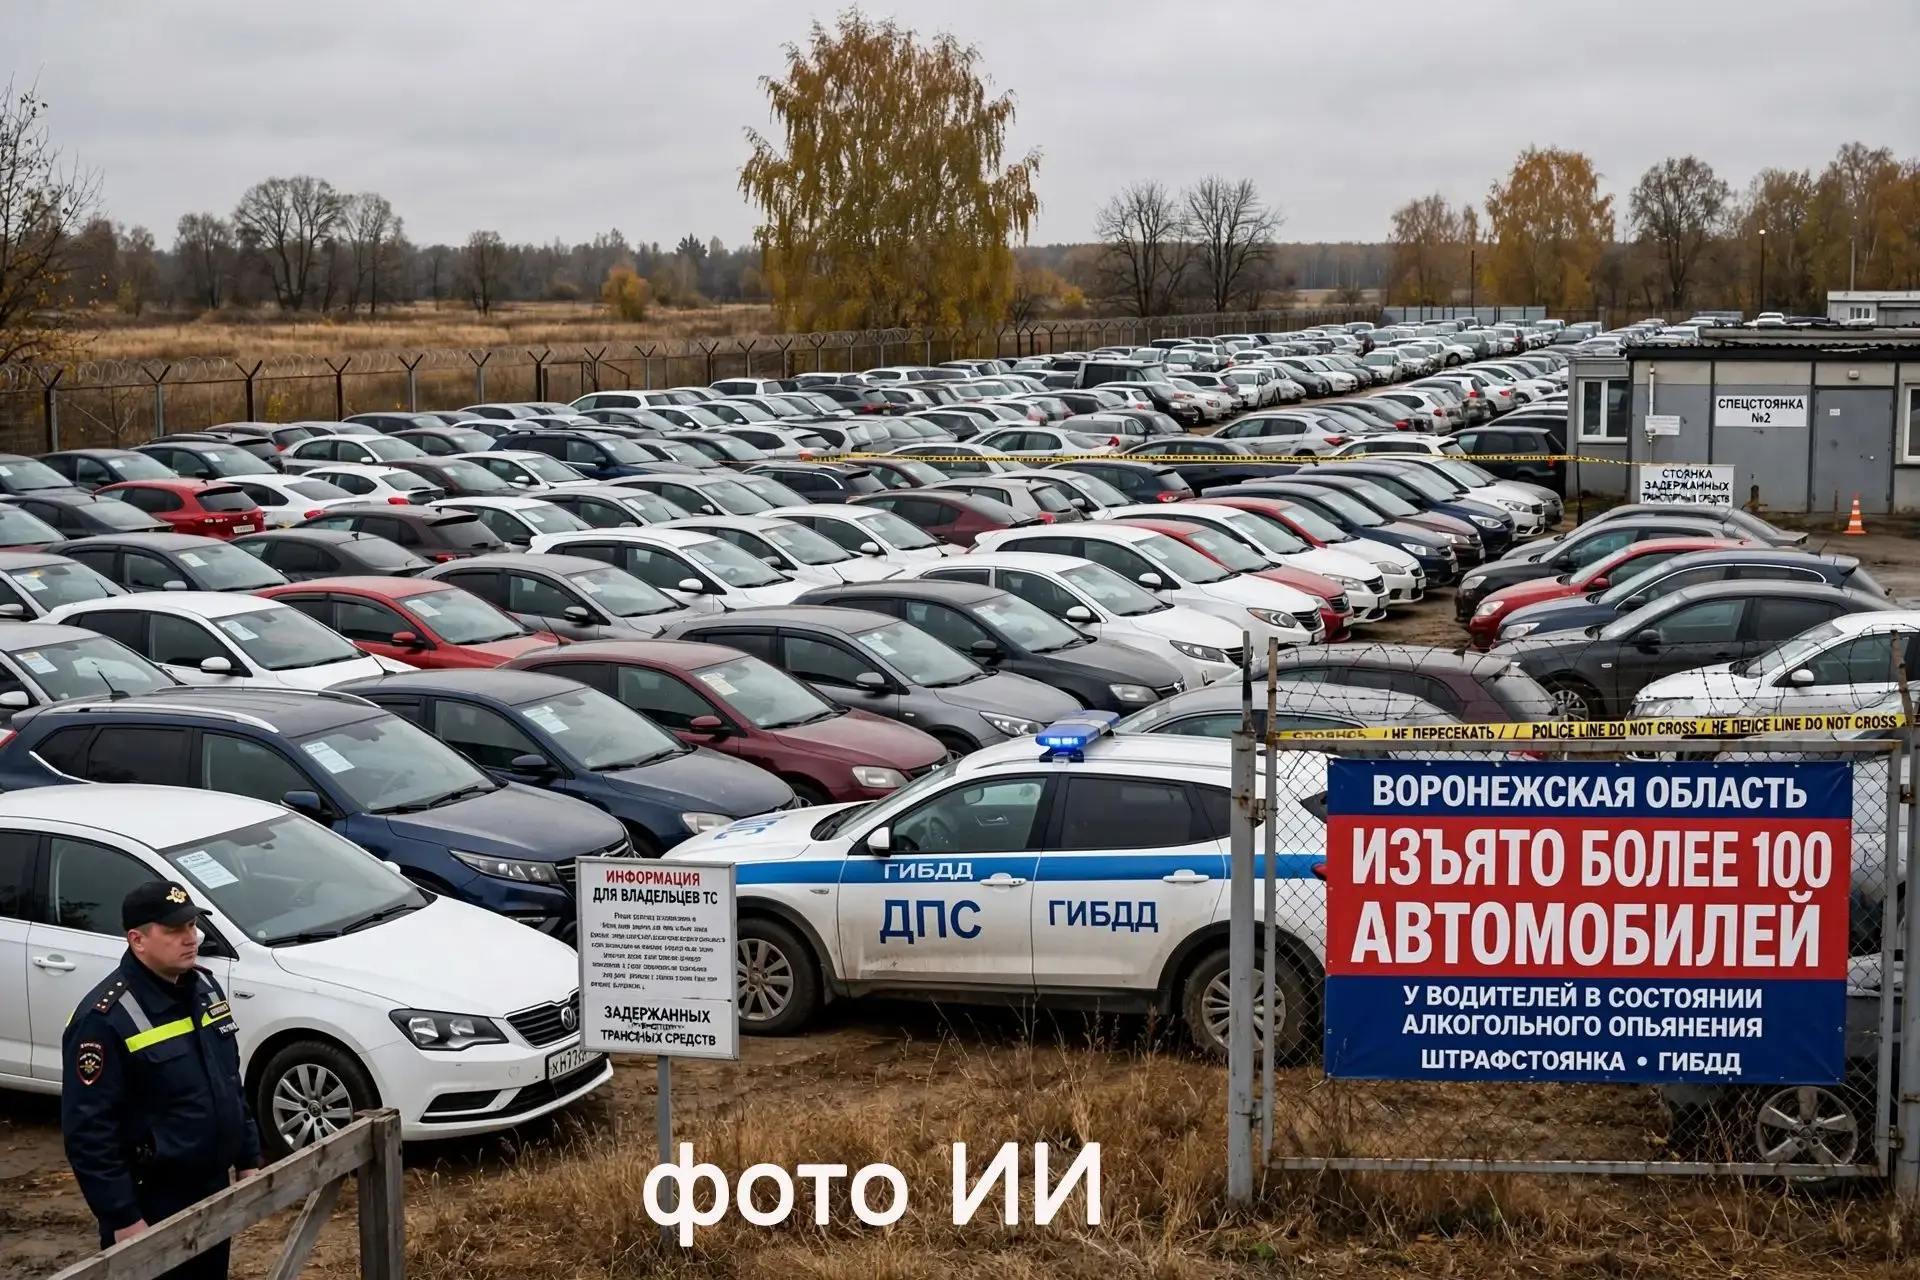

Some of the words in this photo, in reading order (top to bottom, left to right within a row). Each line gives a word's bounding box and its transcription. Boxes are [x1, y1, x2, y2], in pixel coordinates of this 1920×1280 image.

[1718, 398, 1804, 411] СПЕЦСТОЯНКА
[1751, 412, 1771, 424] №2
[1662, 468, 1713, 479] СТОЯНКА
[1644, 480, 1730, 491] ЗАДЕРЖАННЫХ
[1391, 728, 1408, 739] НЕ
[1412, 725, 1496, 740] ПЕРЕСЕКАТЬ
[1532, 722, 1575, 739] POLICE
[1579, 723, 1605, 738] LINE
[1609, 722, 1626, 736] DO
[1629, 722, 1654, 736] NOT
[1657, 721, 1698, 735] CROSS
[1774, 717, 1801, 731] LINE
[1805, 716, 1823, 730] DO
[1827, 716, 1852, 729] NOT
[1855, 715, 1898, 729] CROSS
[1372, 774, 1635, 808] ВОРОНЕЖСКАЯ
[1645, 776, 1808, 809] ОБЛАСТЬ
[1351, 827, 1566, 887] ИЗЪЯТО
[1581, 829, 1740, 888] БОЛЕЕ
[1752, 830, 1832, 889] 100
[606, 870, 700, 888] ИНФОРМАЦИЯ
[884, 862, 974, 881] ГИБДД
[593, 887, 617, 903] ДЛЯ
[621, 888, 700, 906] ВЛАДЕЛЬЦЕВ
[703, 891, 718, 905] ТС
[879, 899, 983, 945] ДПС
[1048, 900, 1159, 933] ГИБДД
[1350, 890, 1820, 968] АВТОМОБИЛЕЙ
[1403, 985, 1420, 1006] У
[1426, 982, 1577, 1010] ВОДИТЕЛЕЙ
[1585, 987, 1601, 1007] В
[1608, 987, 1763, 1009] СОСТОЯНИИ
[604, 1005, 711, 1023] ЗАДЕРЖАННЫХ
[1402, 1014, 1601, 1037] АЛКОГОЛЬНОГО
[1608, 1016, 1763, 1038] ОПЬЯНЕНИЯ
[664, 1032, 716, 1047] СРЕДСТВ
[1421, 1049, 1626, 1072] ШТРАФСТОЯНКА
[1658, 1052, 1742, 1075] ГИБДД
